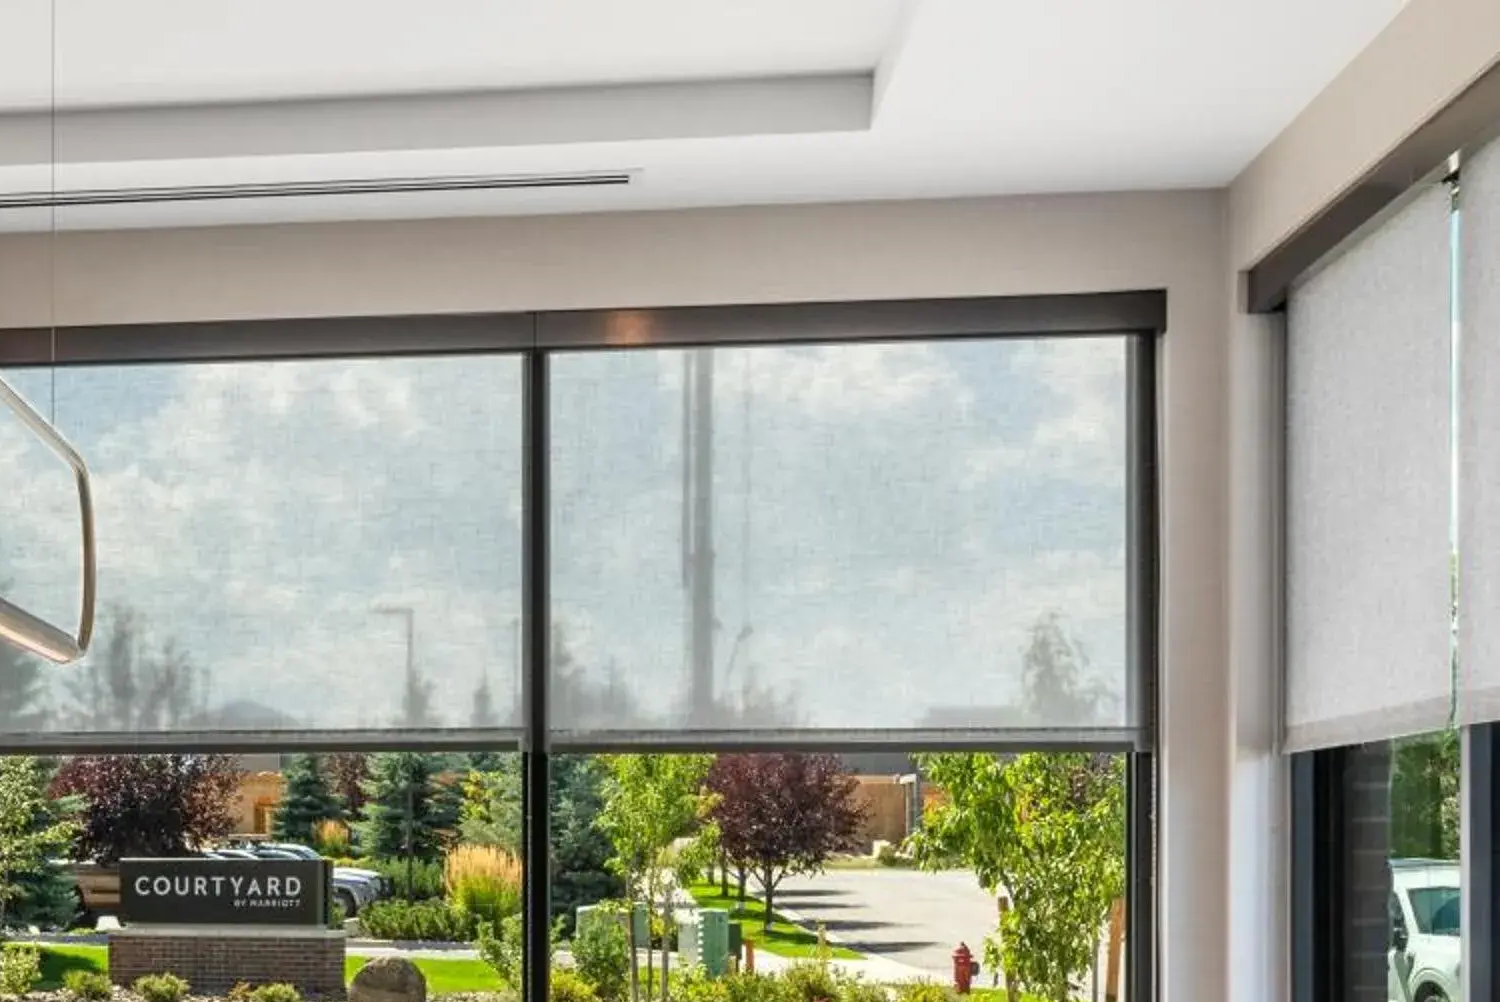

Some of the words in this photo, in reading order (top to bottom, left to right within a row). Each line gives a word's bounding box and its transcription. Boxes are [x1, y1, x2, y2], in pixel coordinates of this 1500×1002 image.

[135, 876, 301, 896] COURTYARD
[233, 899, 246, 907] BY
[249, 899, 301, 907] MARRIOTT
